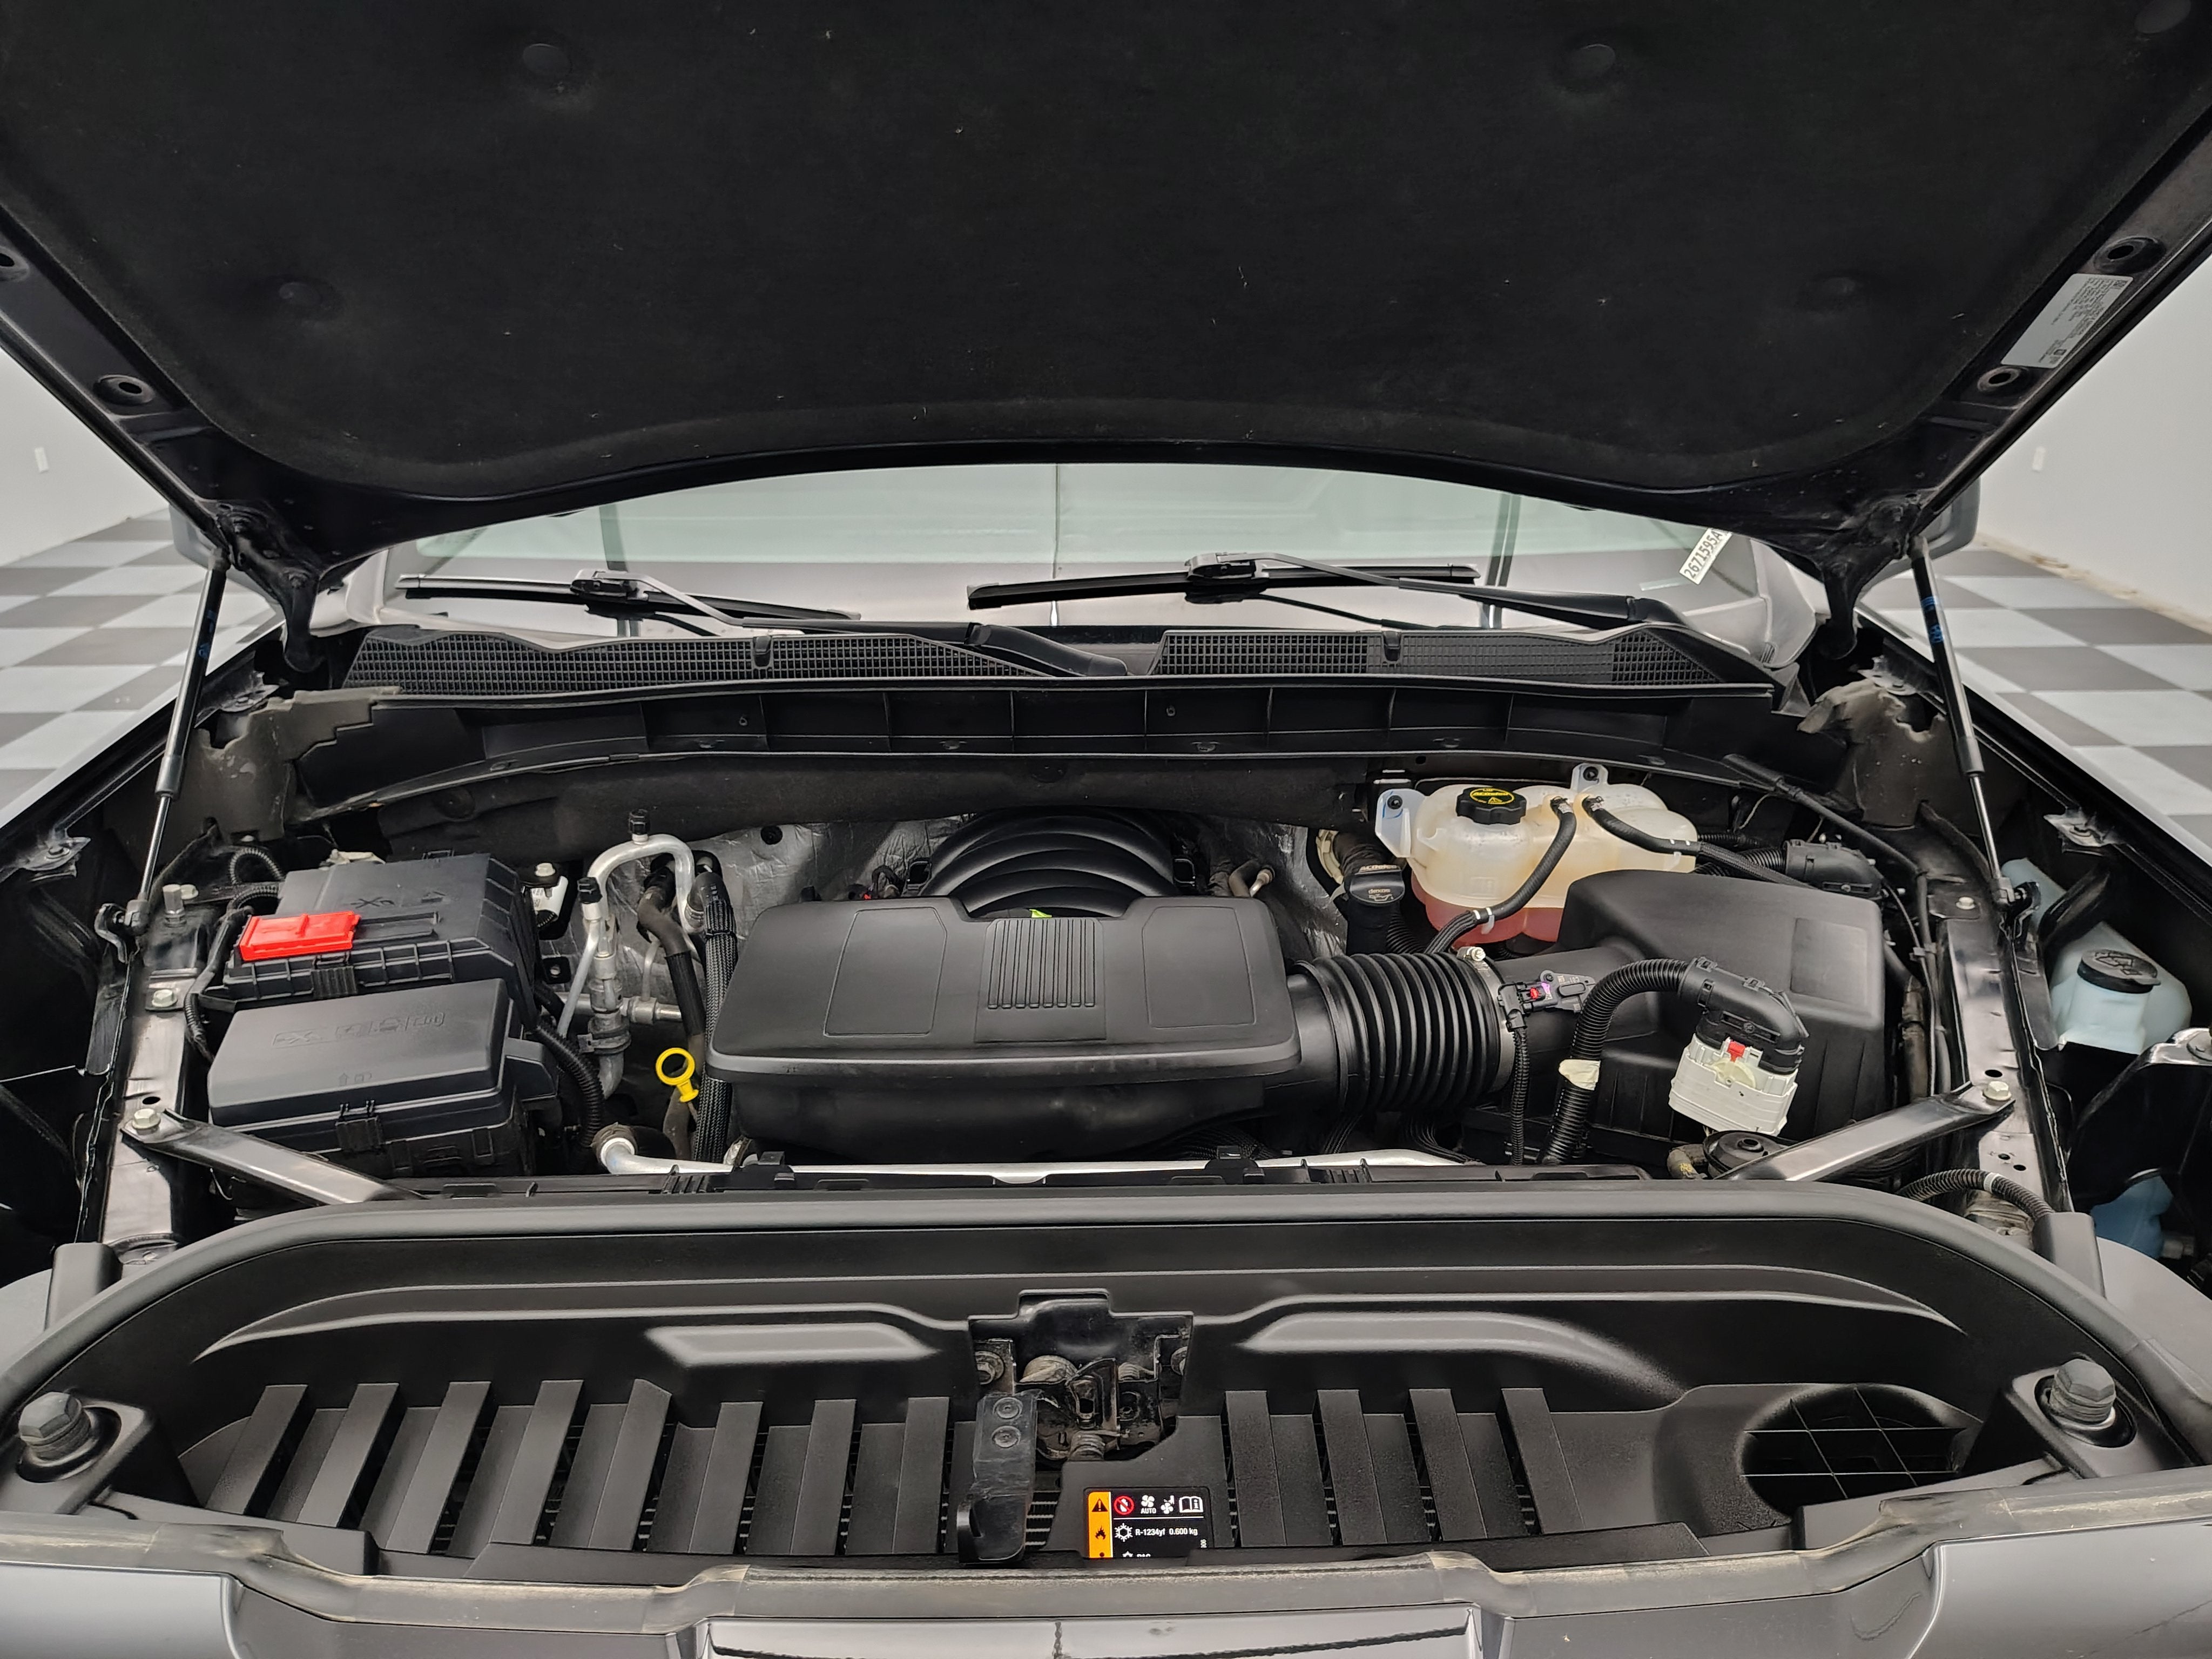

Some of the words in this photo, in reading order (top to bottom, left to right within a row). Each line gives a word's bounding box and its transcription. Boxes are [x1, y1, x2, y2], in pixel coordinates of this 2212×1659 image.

[1684, 530, 1723, 578] 2671595A
[1135, 1528, 1165, 1536] R-1234yf
[1189, 1528, 1198, 1536] kg
